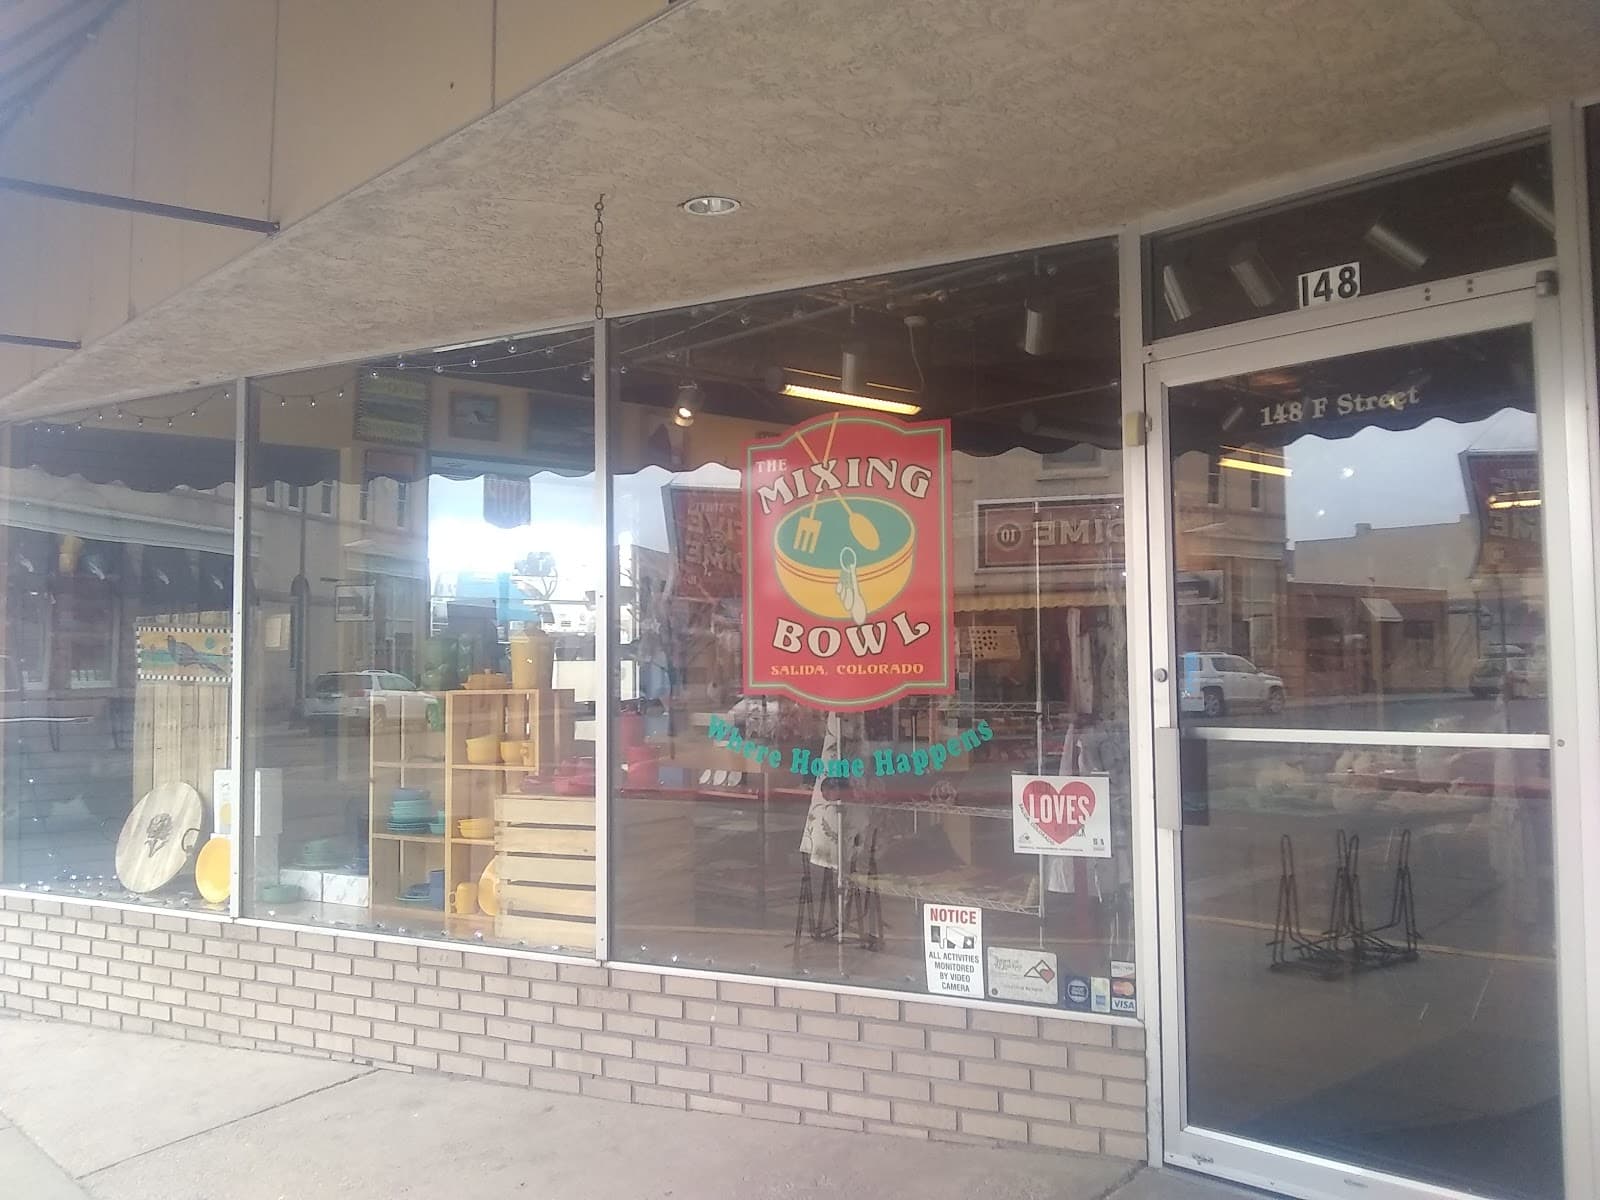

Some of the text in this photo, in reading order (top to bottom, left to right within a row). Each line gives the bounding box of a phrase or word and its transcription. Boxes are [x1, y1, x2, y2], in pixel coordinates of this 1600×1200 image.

[1302, 266, 1358, 307] 148
[1260, 385, 1419, 426] 148 F Street
[756, 458, 787, 473] THE
[757, 457, 933, 514] MIXING
[772, 611, 930, 658] BOWL
[837, 663, 924, 675] COLORADO
[708, 714, 994, 778] Where Home Happens
[1028, 794, 1091, 825] LOVES
[930, 908, 977, 925] NOTICE
[929, 951, 942, 960] ALL
[943, 952, 979, 964] ACTIVITIES
[934, 961, 975, 974] MONITORED
[940, 972, 971, 983] BY VIDEO
[942, 982, 970, 993] CAMERA
[1114, 999, 1135, 1010] VISA
